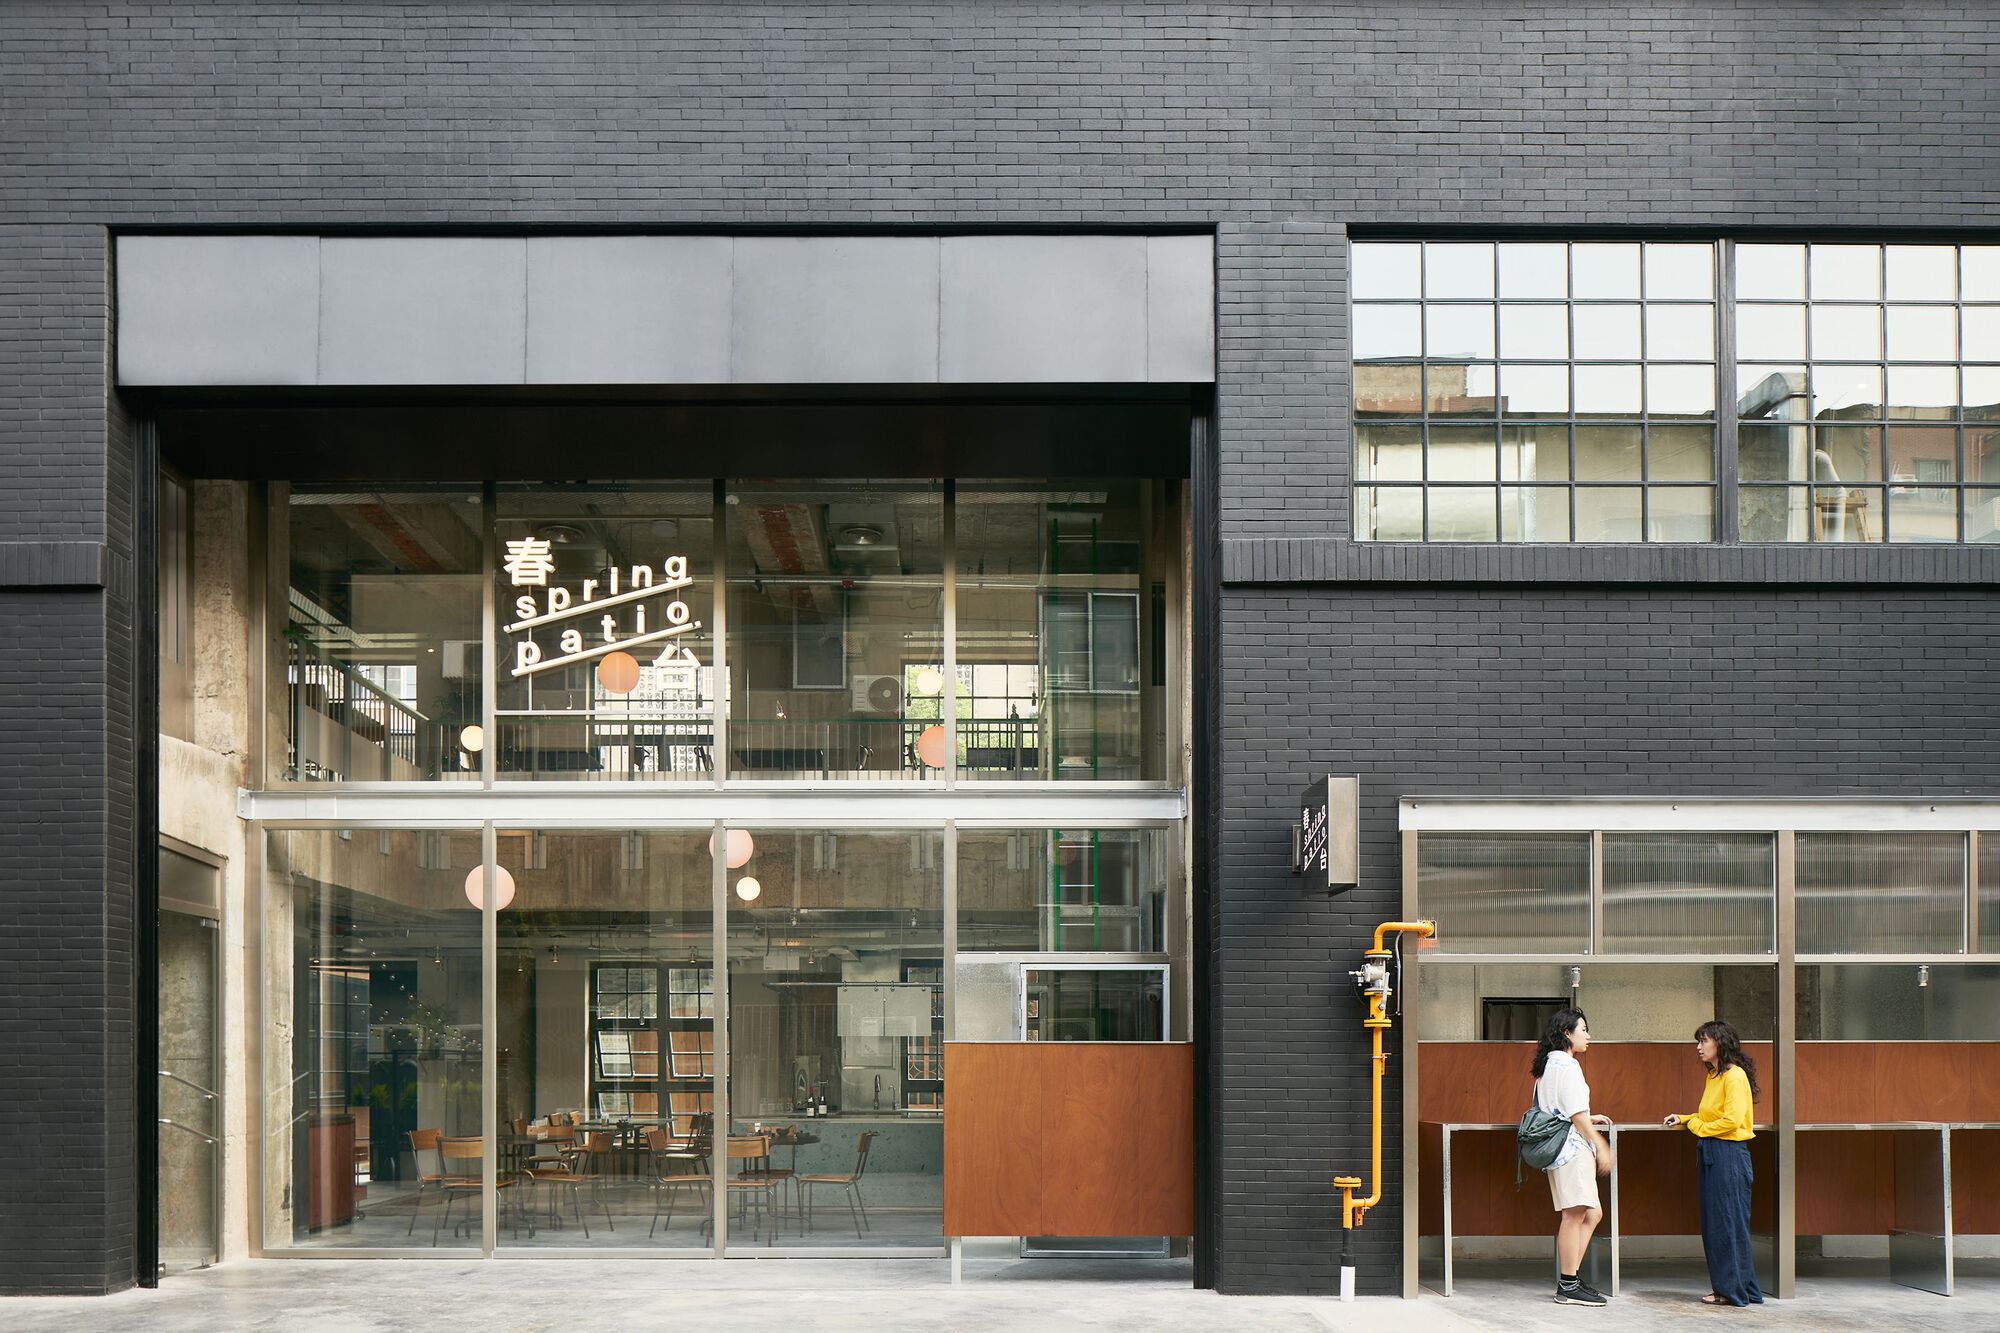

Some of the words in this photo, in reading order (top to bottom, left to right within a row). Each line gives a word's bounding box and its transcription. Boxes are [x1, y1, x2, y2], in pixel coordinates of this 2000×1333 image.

[503, 536, 556, 587] 春
[516, 555, 692, 619] spring
[517, 600, 691, 671] patio
[652, 643, 701, 692] 台
[1304, 804, 1326, 845] spring
[1304, 826, 1326, 871] patio
